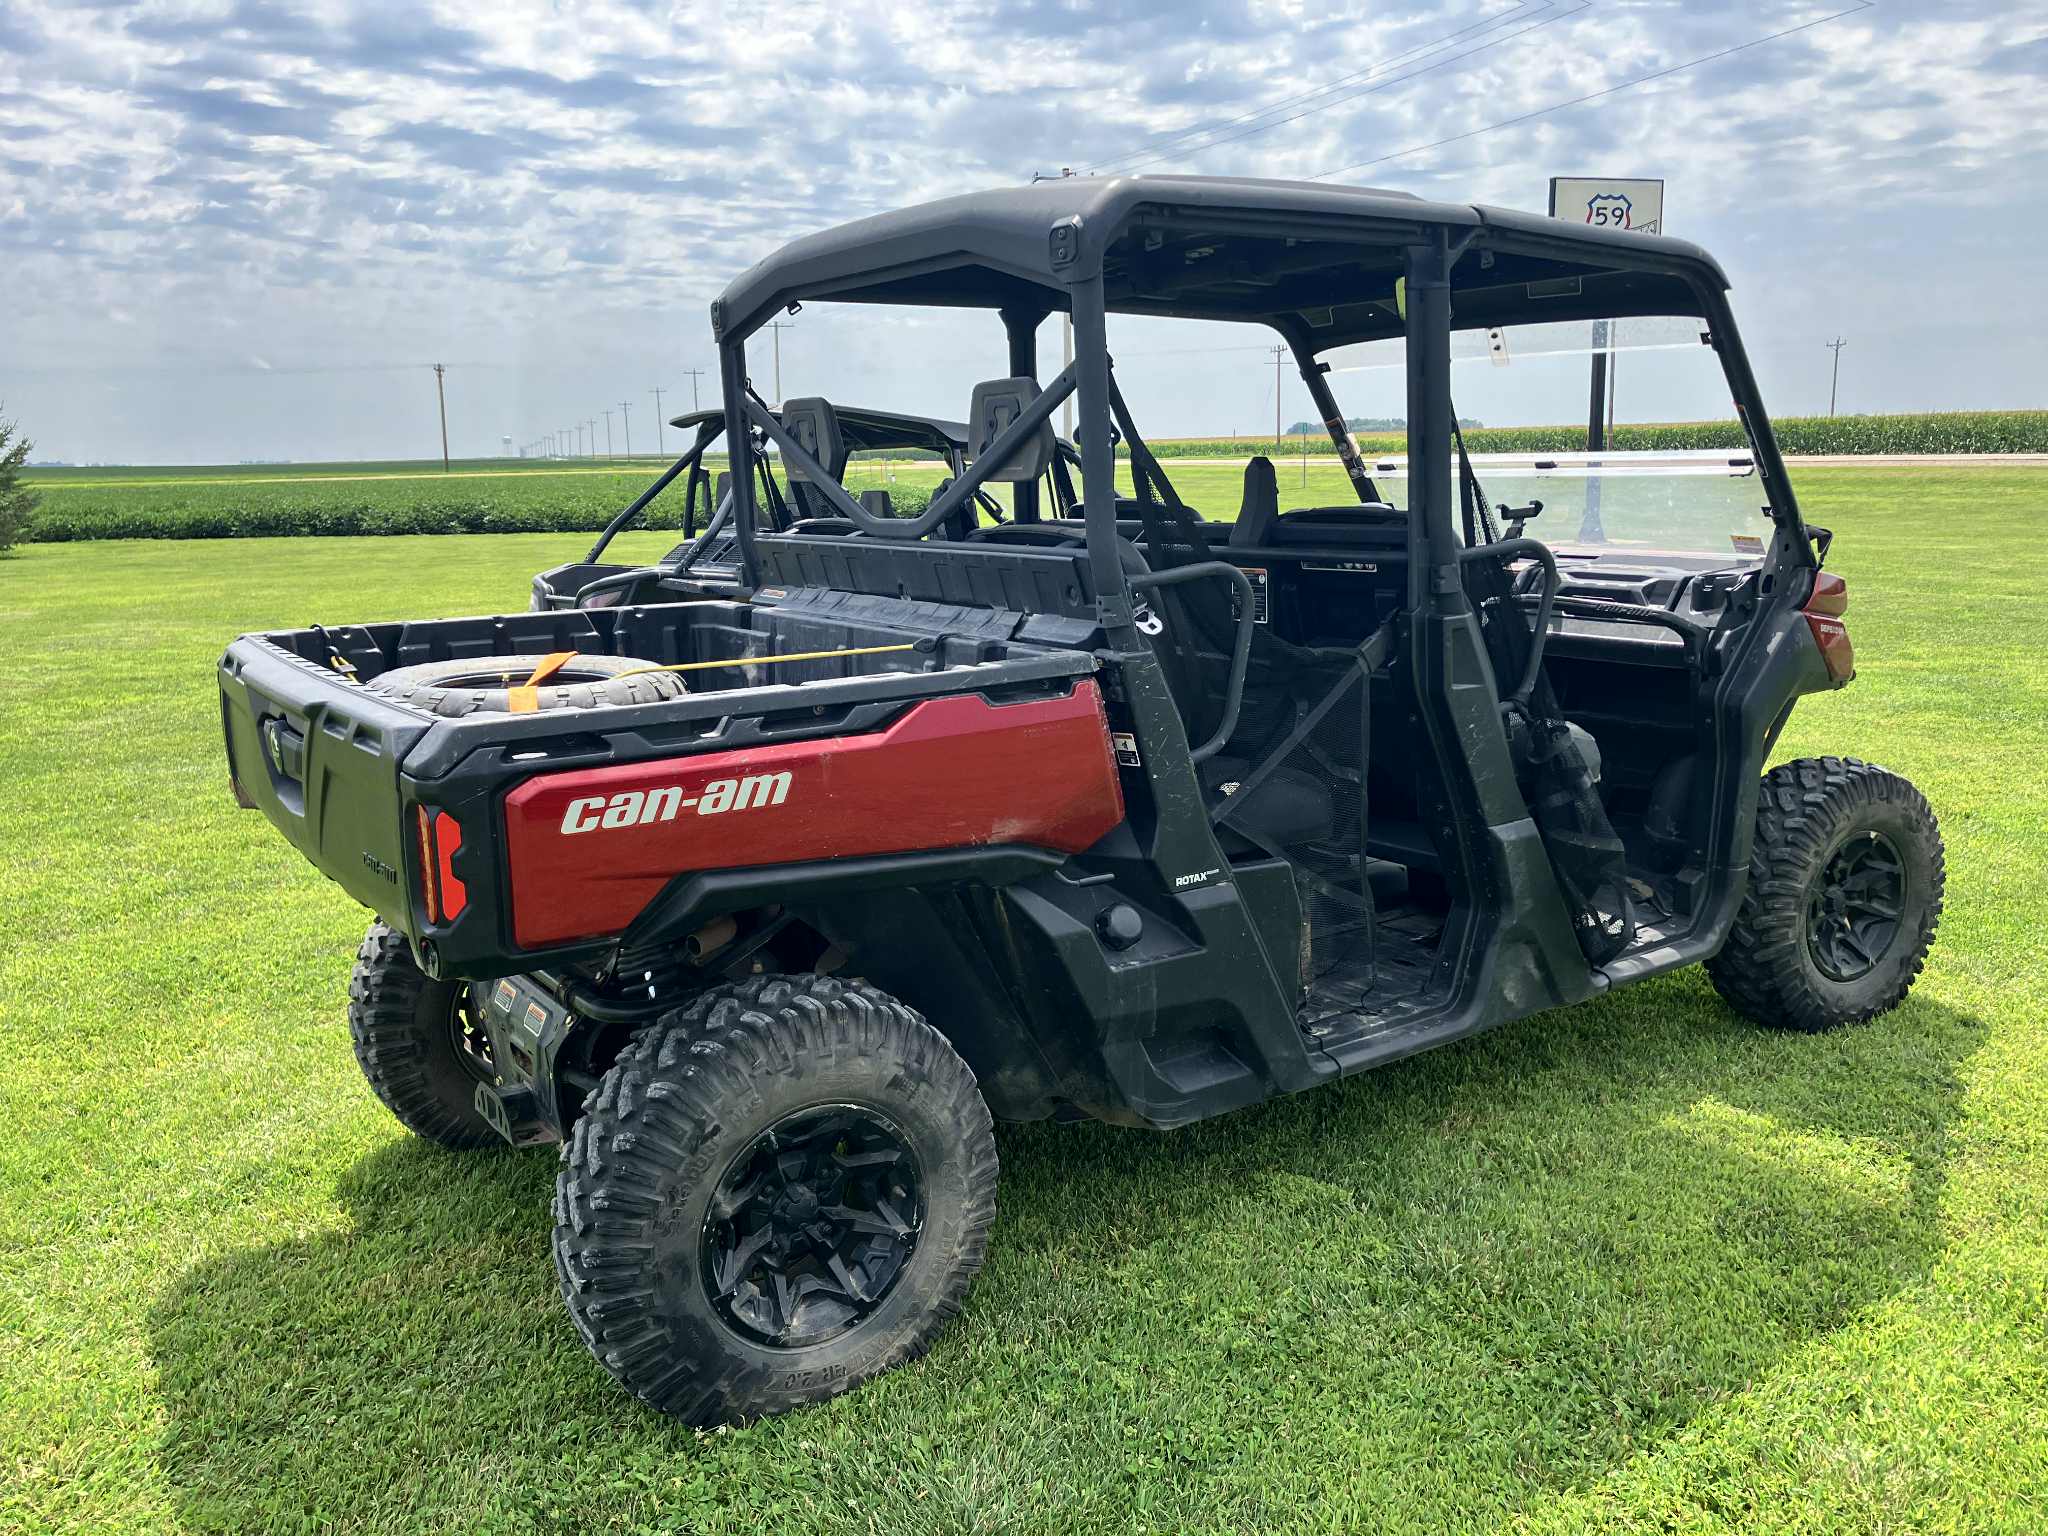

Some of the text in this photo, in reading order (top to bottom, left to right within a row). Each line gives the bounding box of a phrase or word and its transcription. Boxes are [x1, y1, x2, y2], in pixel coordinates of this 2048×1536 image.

[1595, 207, 1624, 226] 59
[561, 771, 793, 835] can-am
[1175, 872, 1207, 887] ROTAX
